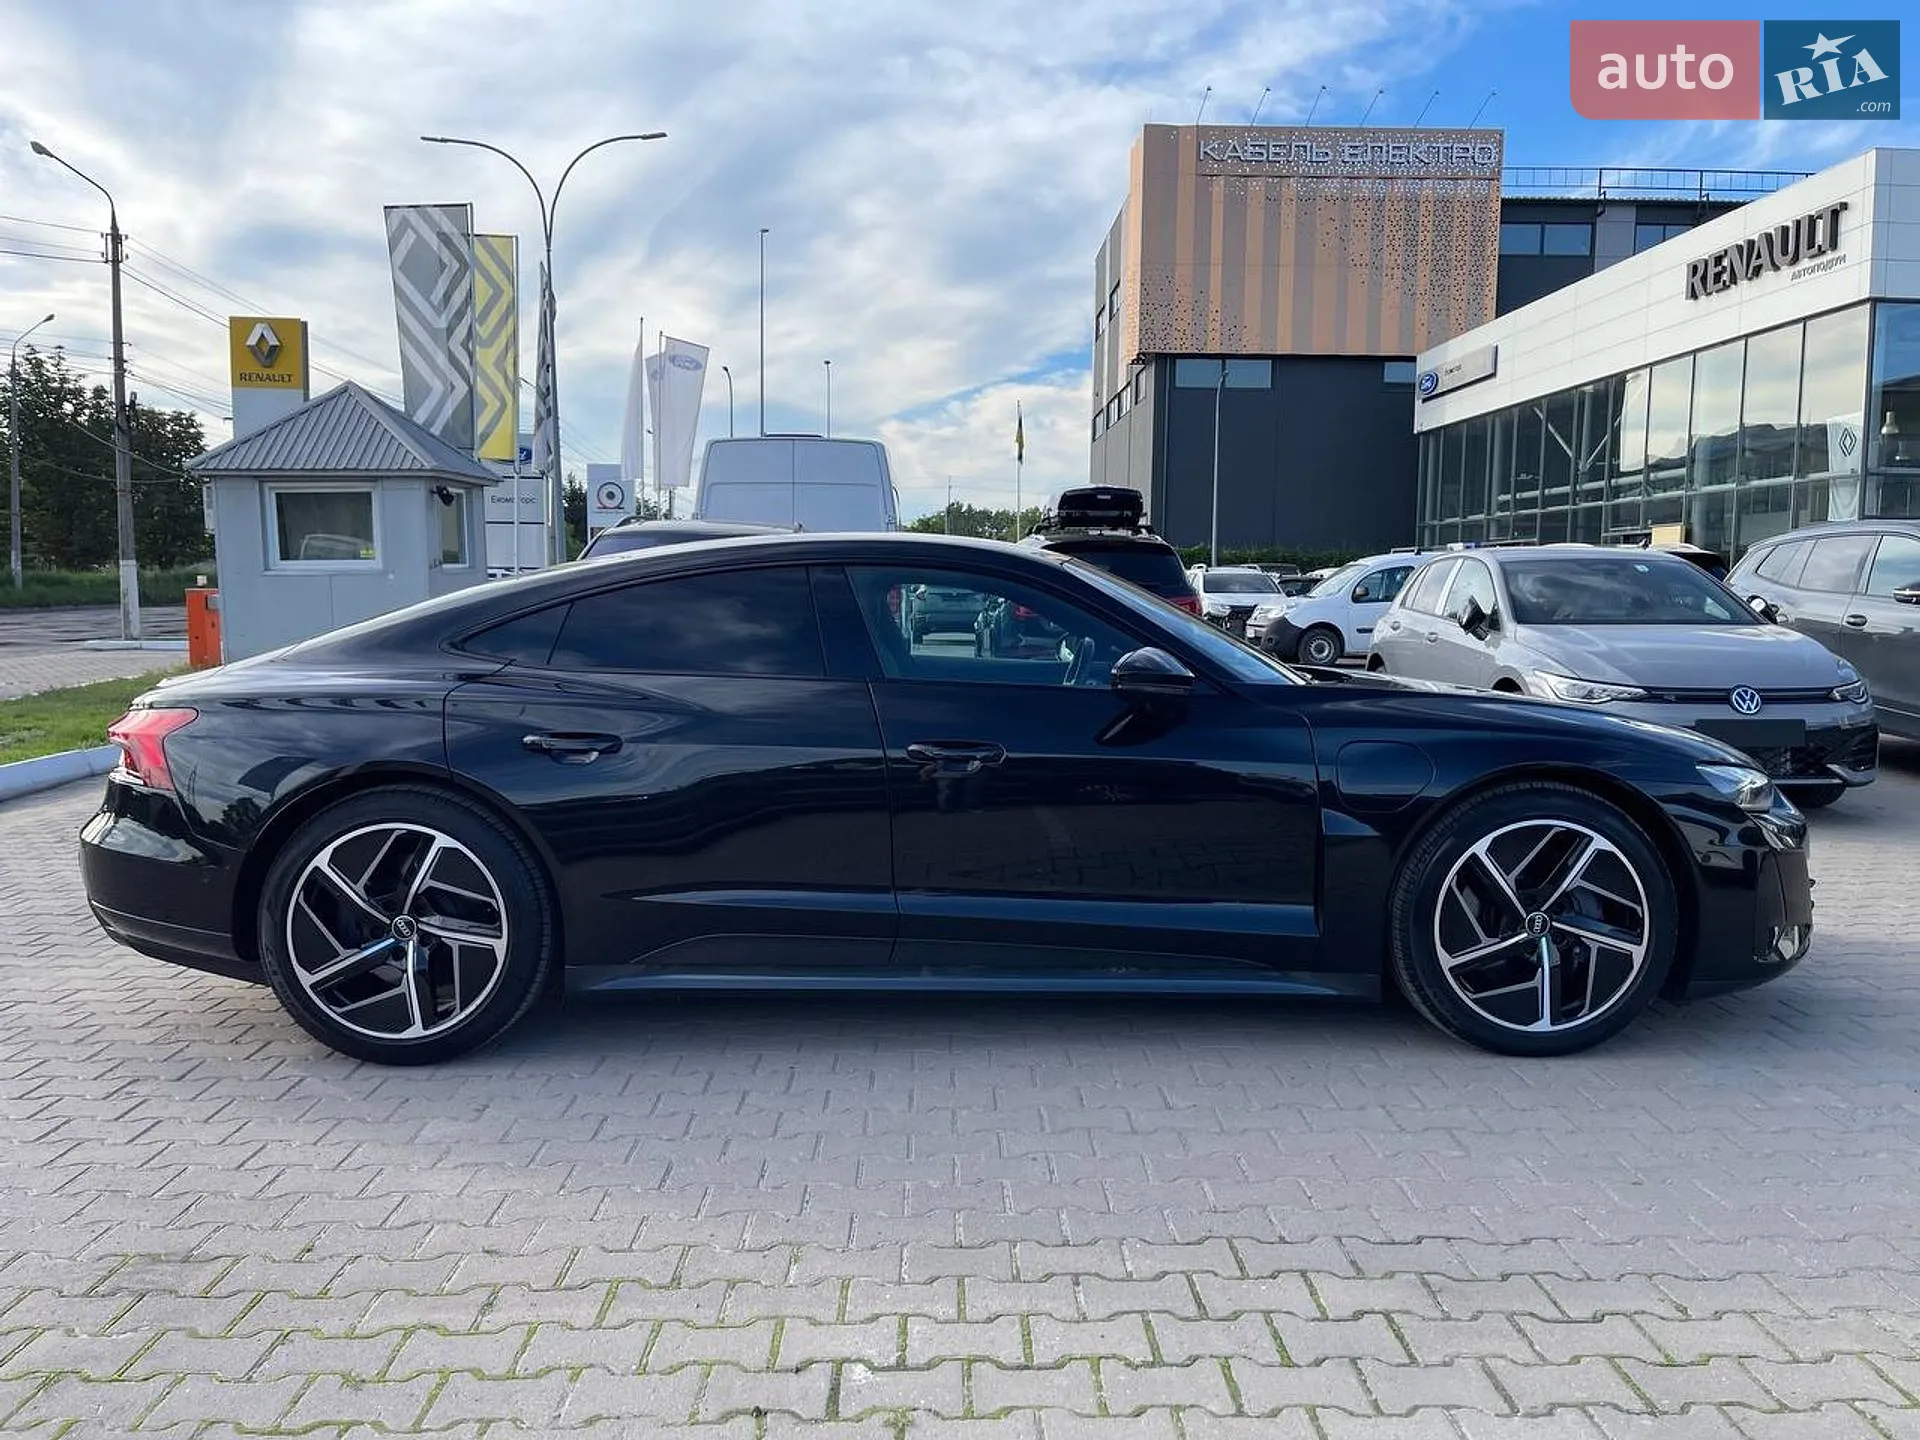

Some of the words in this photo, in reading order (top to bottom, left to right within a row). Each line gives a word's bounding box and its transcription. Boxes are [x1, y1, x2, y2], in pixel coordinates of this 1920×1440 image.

[1199, 139, 1331, 162] КАБЕЛЬ
[1342, 141, 1498, 165] ЕЛЕКТРО
[1684, 201, 1849, 301] RENAULT
[239, 372, 294, 384] RENAULT
[490, 495, 538, 505] Екомоорс
